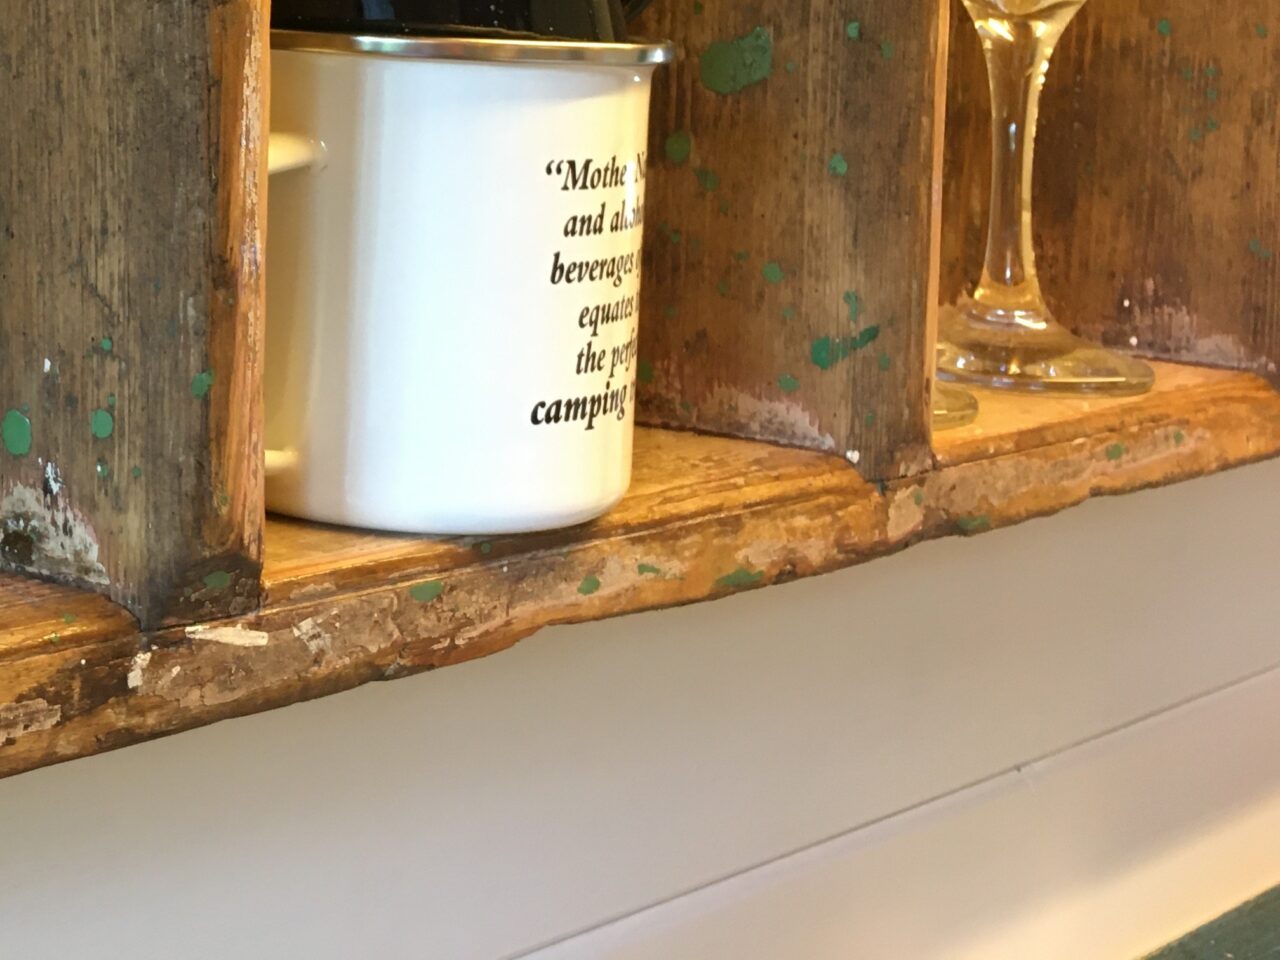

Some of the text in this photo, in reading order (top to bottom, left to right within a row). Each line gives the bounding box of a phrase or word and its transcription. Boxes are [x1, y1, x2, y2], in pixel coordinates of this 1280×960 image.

[545, 155, 628, 191] “Mothe
[563, 201, 606, 237] and
[549, 251, 634, 288] beverages
[578, 295, 634, 337] equates
[576, 327, 637, 379] the perfe
[530, 380, 627, 430] camping
